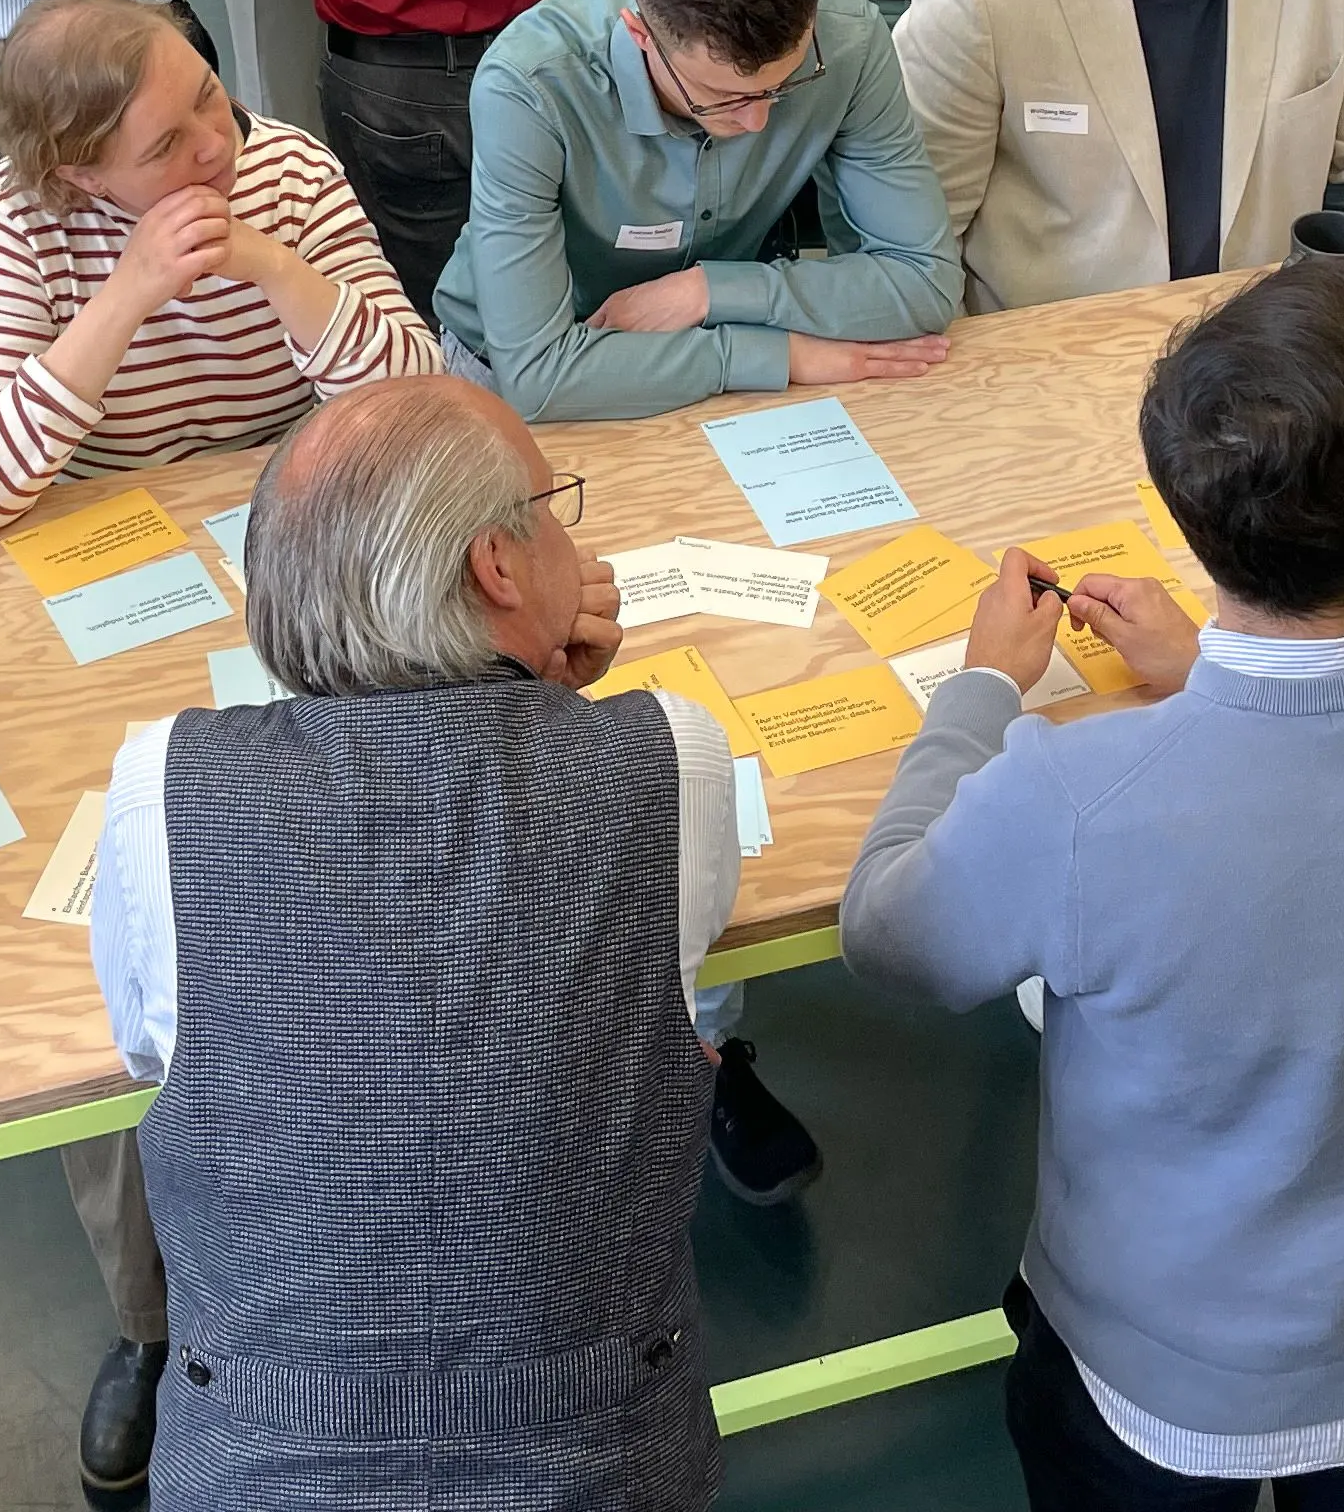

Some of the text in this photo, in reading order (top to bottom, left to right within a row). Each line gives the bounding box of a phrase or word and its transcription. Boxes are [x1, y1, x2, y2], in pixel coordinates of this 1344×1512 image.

[746, 585, 807, 599] Einfachen und
[774, 596, 806, 606] Aktuell
[755, 715, 771, 724] Nur
[782, 700, 833, 718] Verbindung
[764, 729, 784, 739] wird
[849, 708, 870, 718] dass
[871, 704, 887, 713] das
[768, 725, 836, 747] Einfache Bauen
